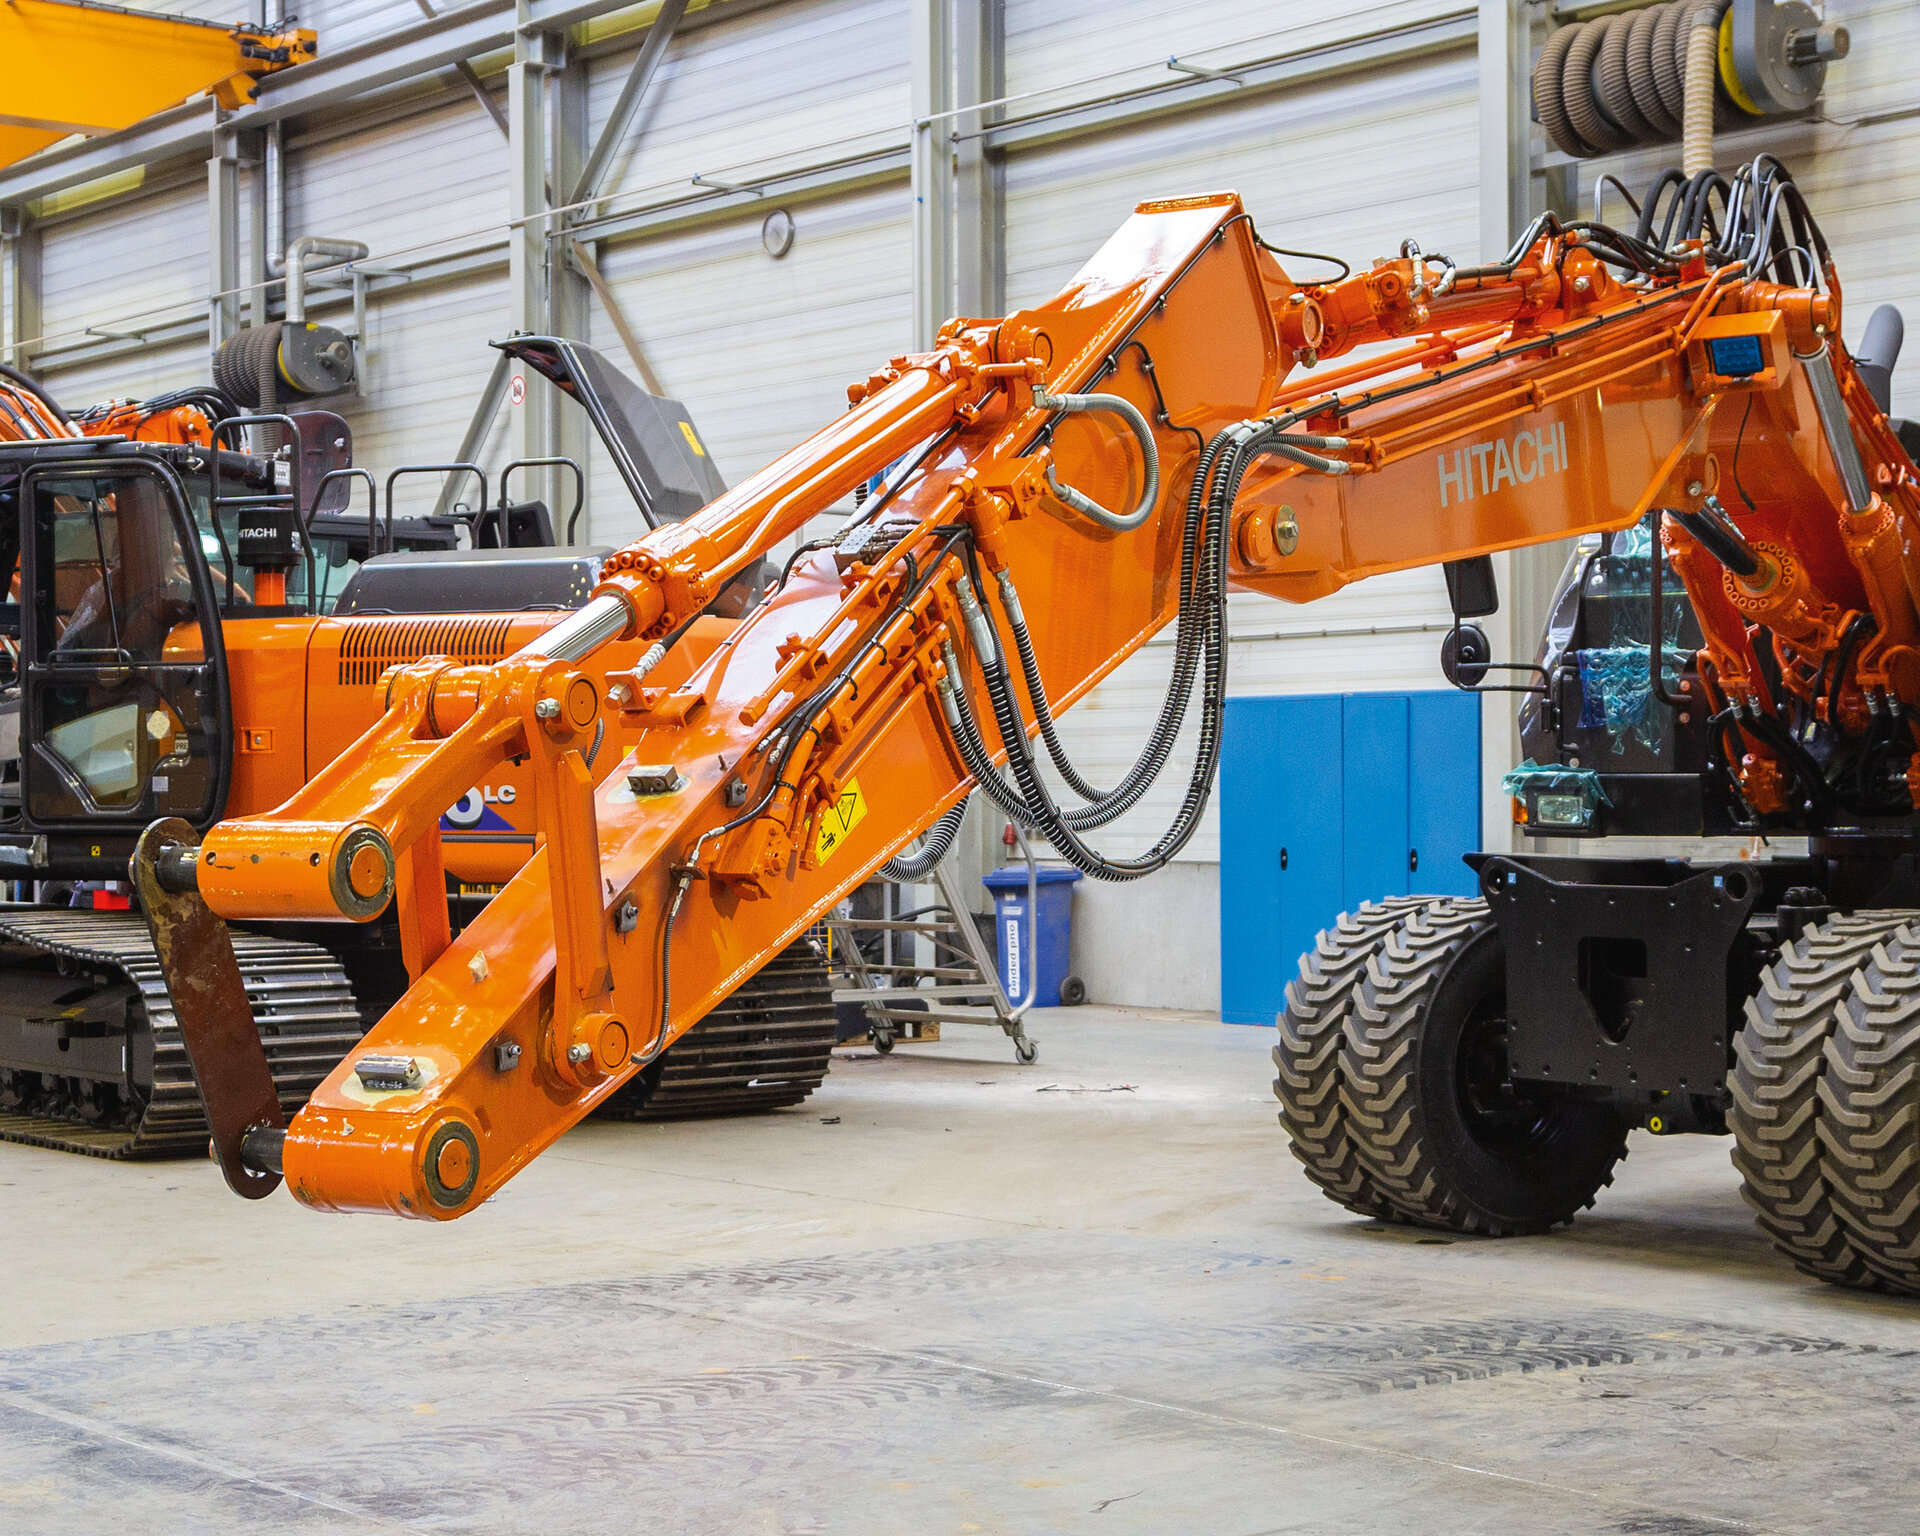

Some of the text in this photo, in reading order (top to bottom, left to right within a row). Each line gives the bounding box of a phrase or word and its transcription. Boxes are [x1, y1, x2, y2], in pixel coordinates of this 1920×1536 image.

[1437, 421, 1568, 508] HITACHI
[1009, 924, 1018, 949] oud
[1010, 953, 1019, 993] papier
